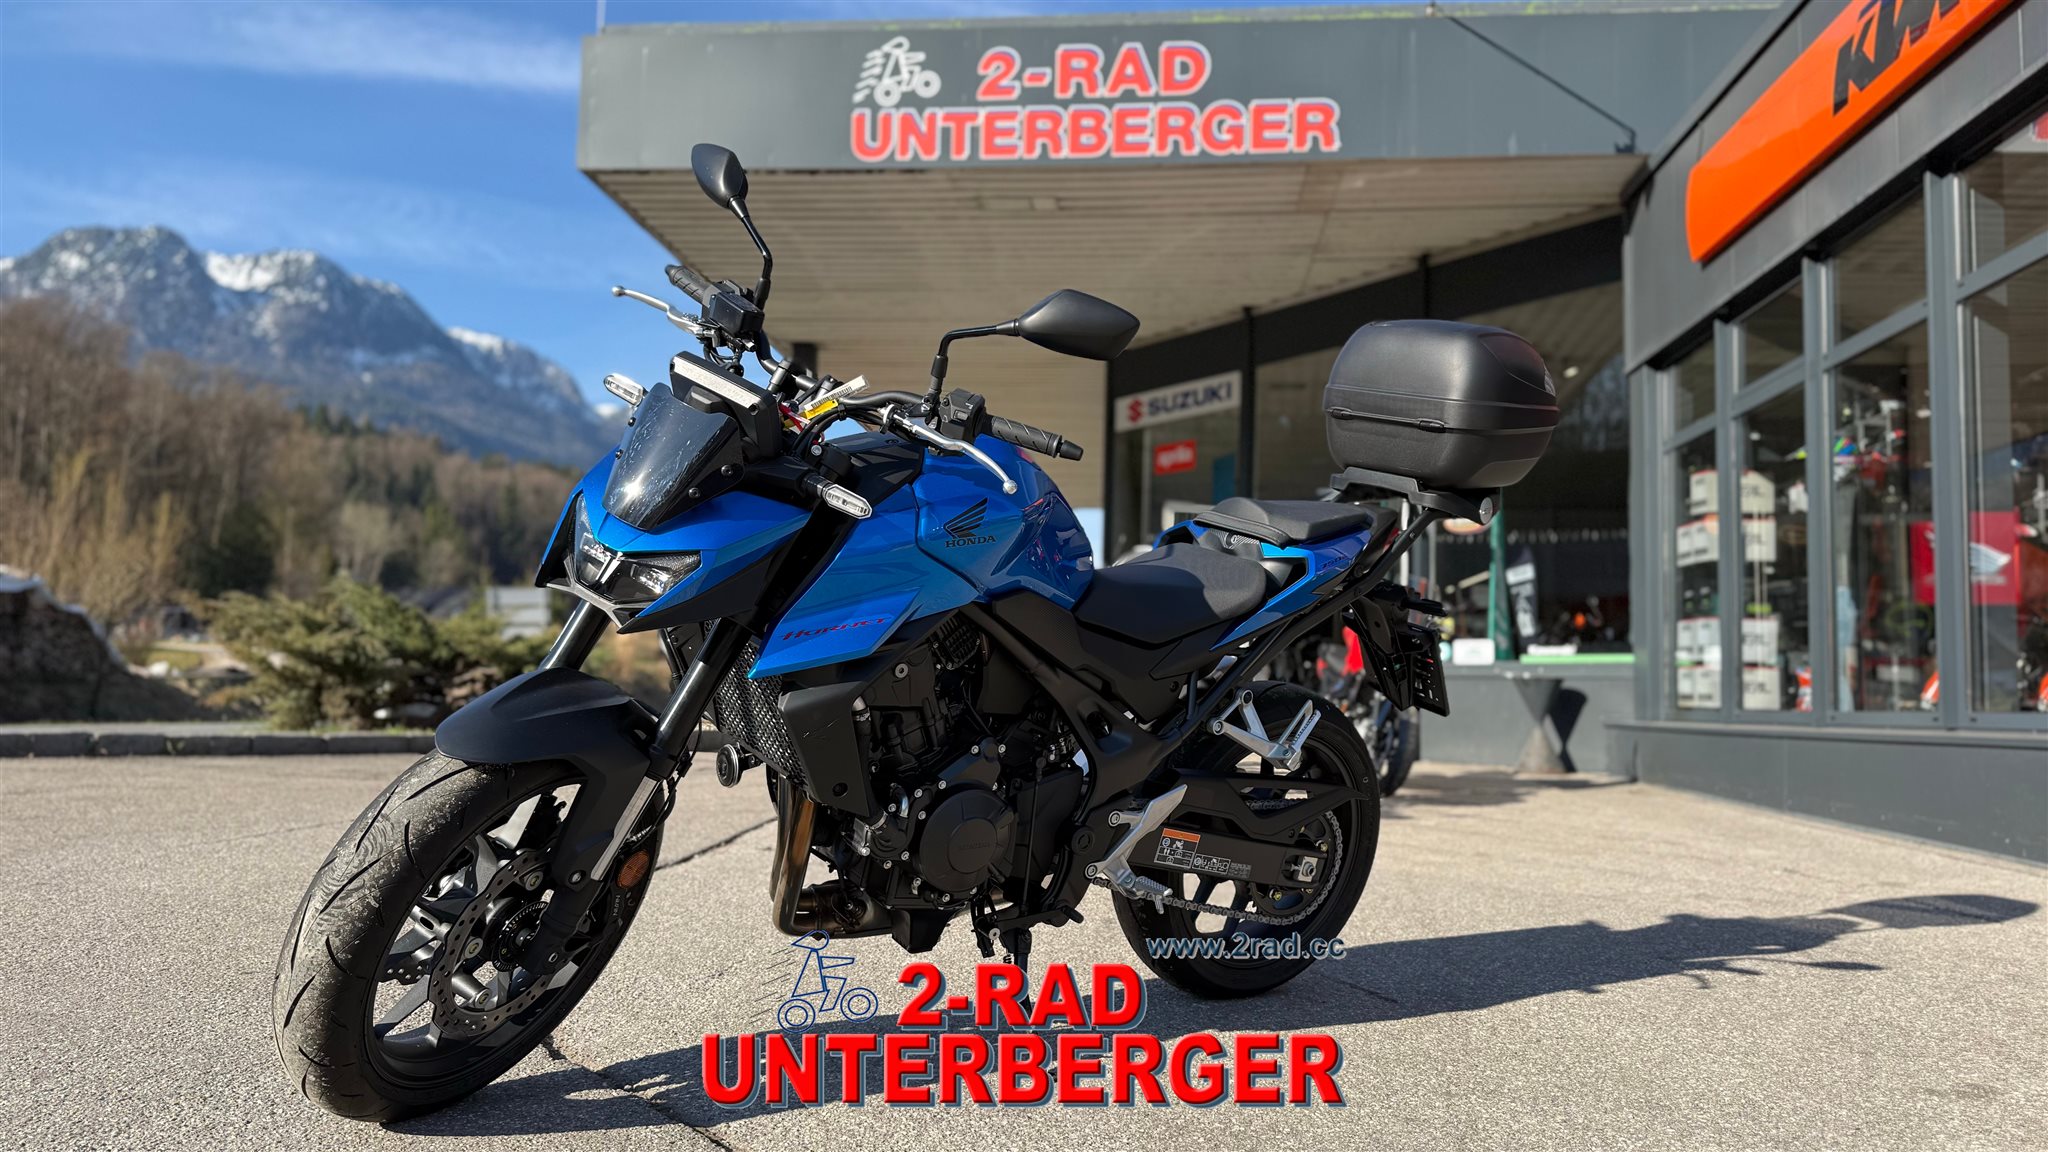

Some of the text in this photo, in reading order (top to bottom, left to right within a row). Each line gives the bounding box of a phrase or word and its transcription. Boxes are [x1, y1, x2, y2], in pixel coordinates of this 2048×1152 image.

[977, 41, 1212, 101] 2-RAD
[850, 97, 1341, 162] UNTERBERGER
[1149, 381, 1232, 416] SUZUKI
[945, 535, 997, 548] HONDA
